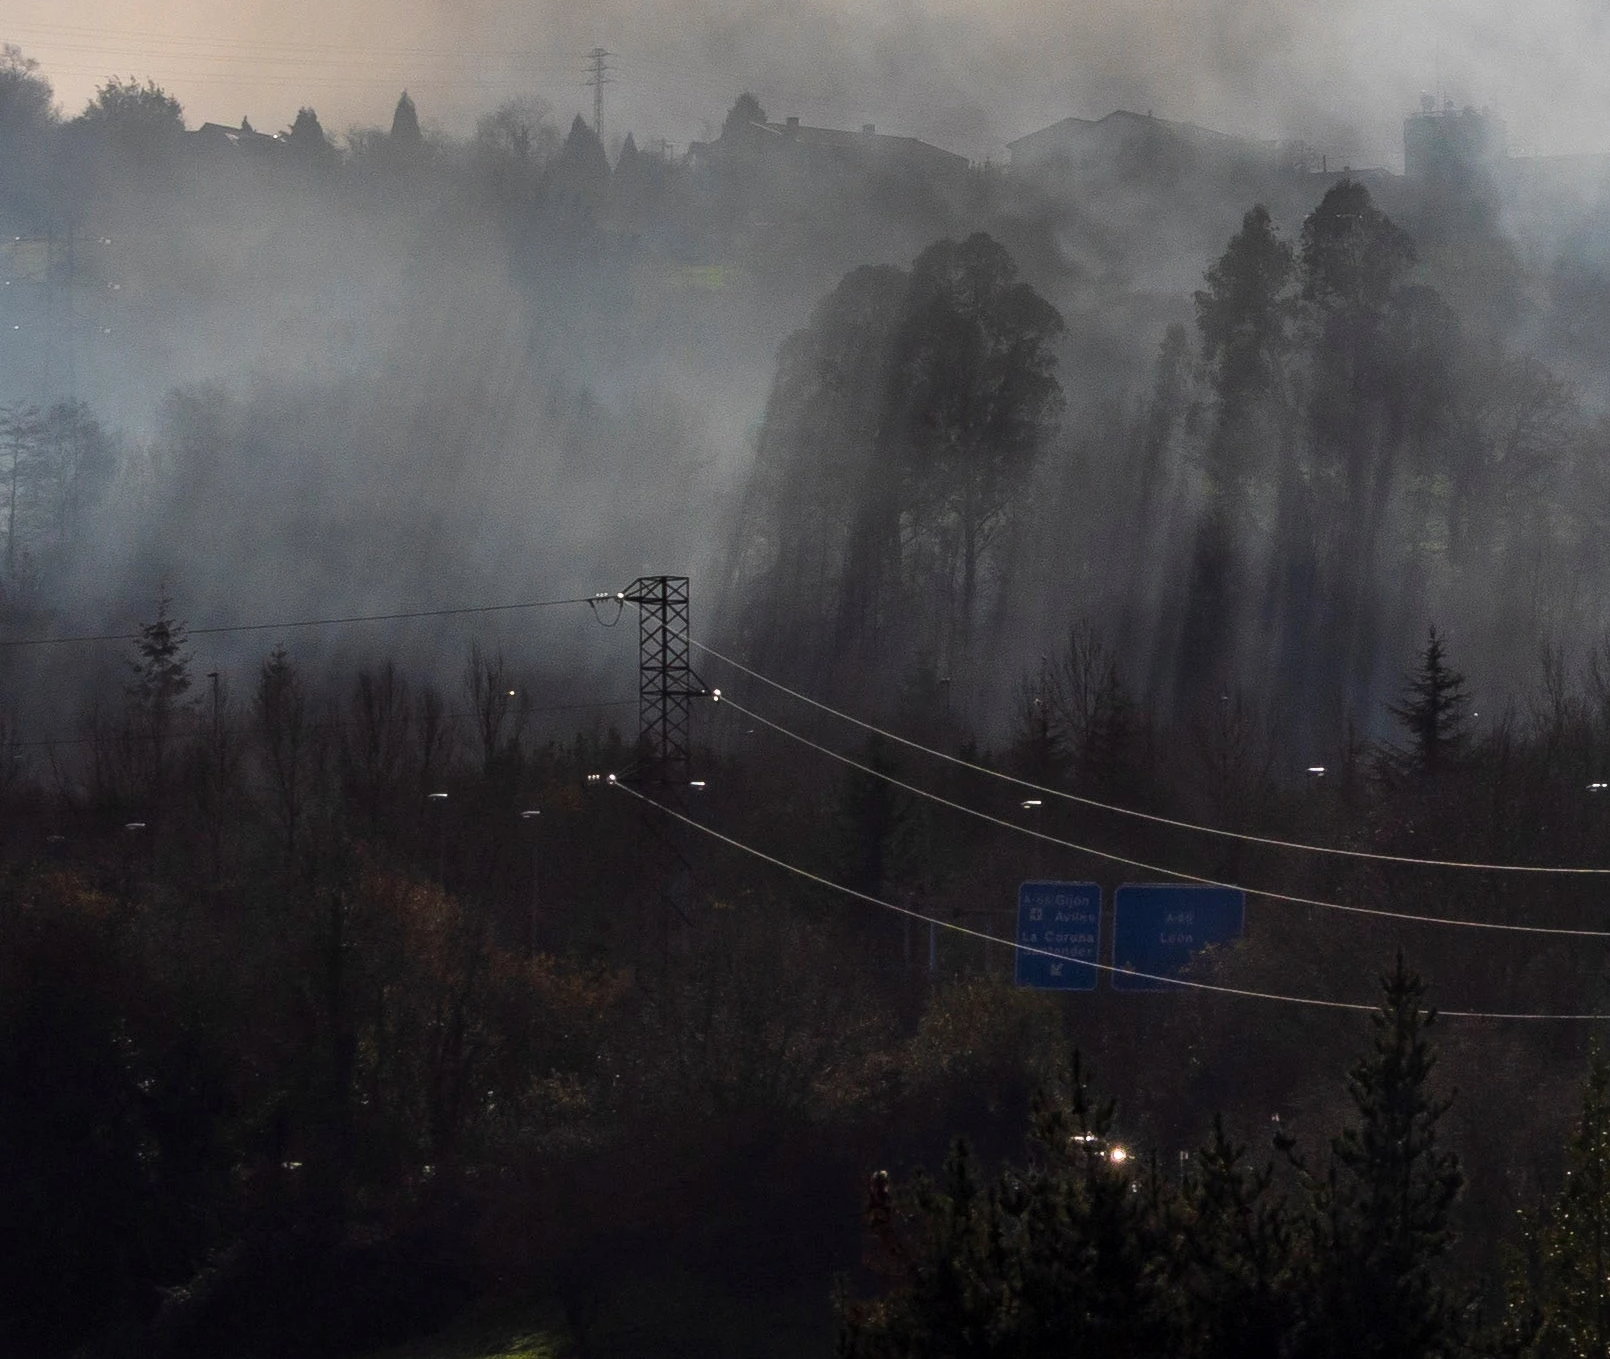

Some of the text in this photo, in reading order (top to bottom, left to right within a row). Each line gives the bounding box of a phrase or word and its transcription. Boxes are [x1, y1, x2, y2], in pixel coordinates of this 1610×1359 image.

[1055, 894, 1090, 909] Gijón
[1021, 931, 1037, 943] La
[1160, 932, 1193, 944] León
